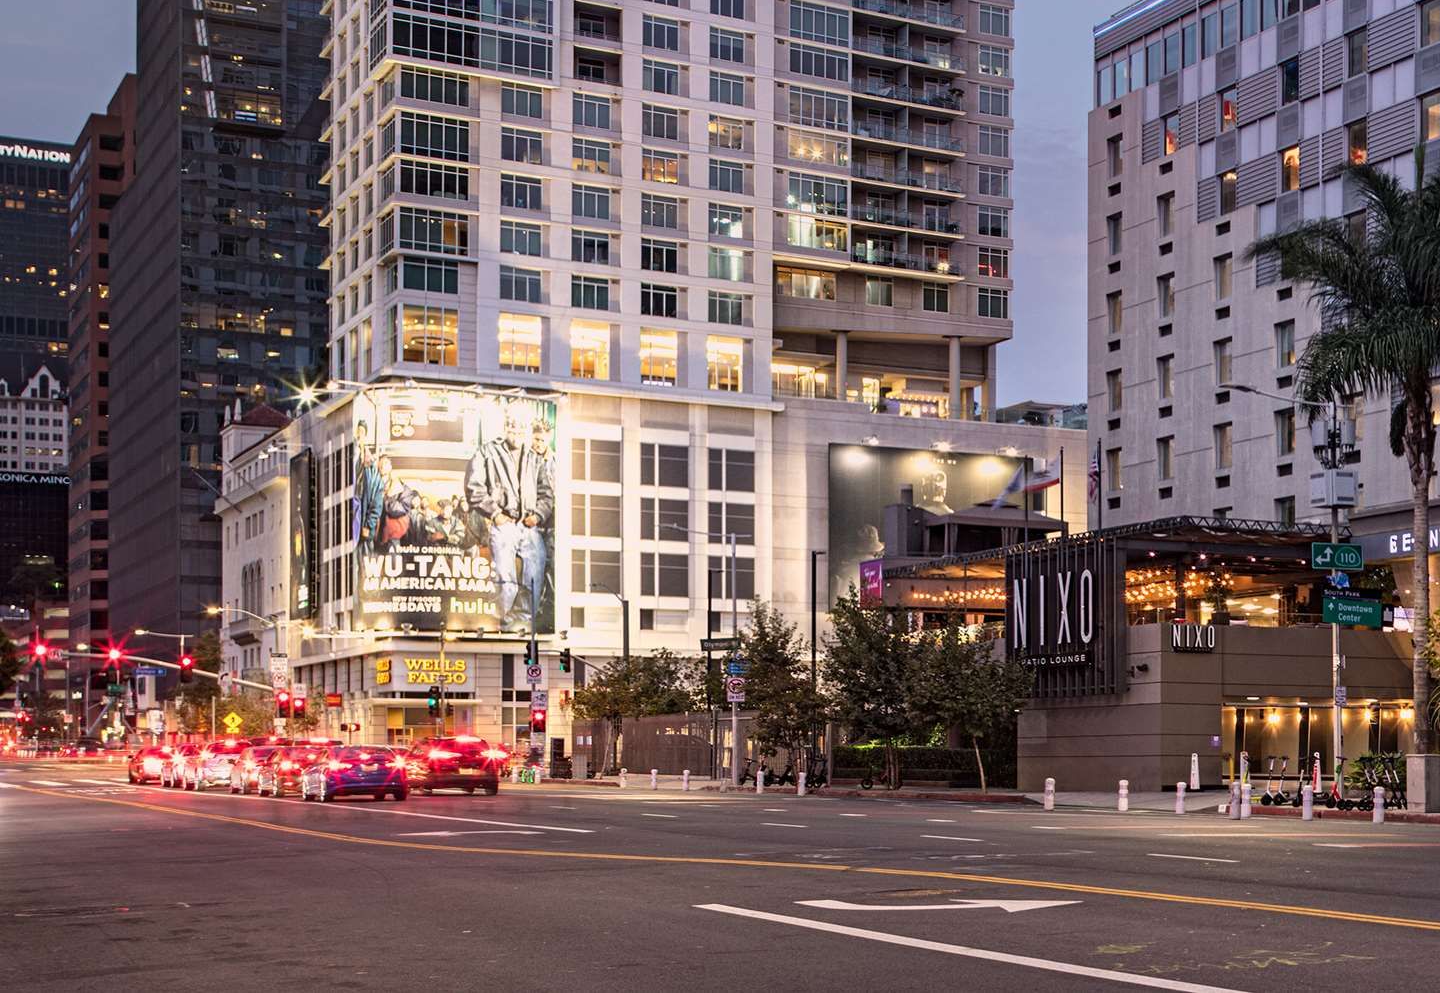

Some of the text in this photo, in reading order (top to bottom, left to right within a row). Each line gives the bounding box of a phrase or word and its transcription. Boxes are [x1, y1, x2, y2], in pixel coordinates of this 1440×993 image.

[396, 545, 420, 554] hulu
[421, 547, 462, 555] ORIGINAL
[1340, 552, 1356, 563] 110
[363, 555, 497, 579] WU-TANG:
[380, 577, 456, 591] AMERICAN
[457, 579, 496, 593] SAGA
[450, 597, 497, 615] hulu
[1013, 569, 1093, 649] NIXO
[1338, 603, 1373, 613] Downtown
[1338, 613, 1361, 622] Center
[1173, 625, 1215, 647] NIXO
[1049, 654, 1086, 664] LOUNGE
